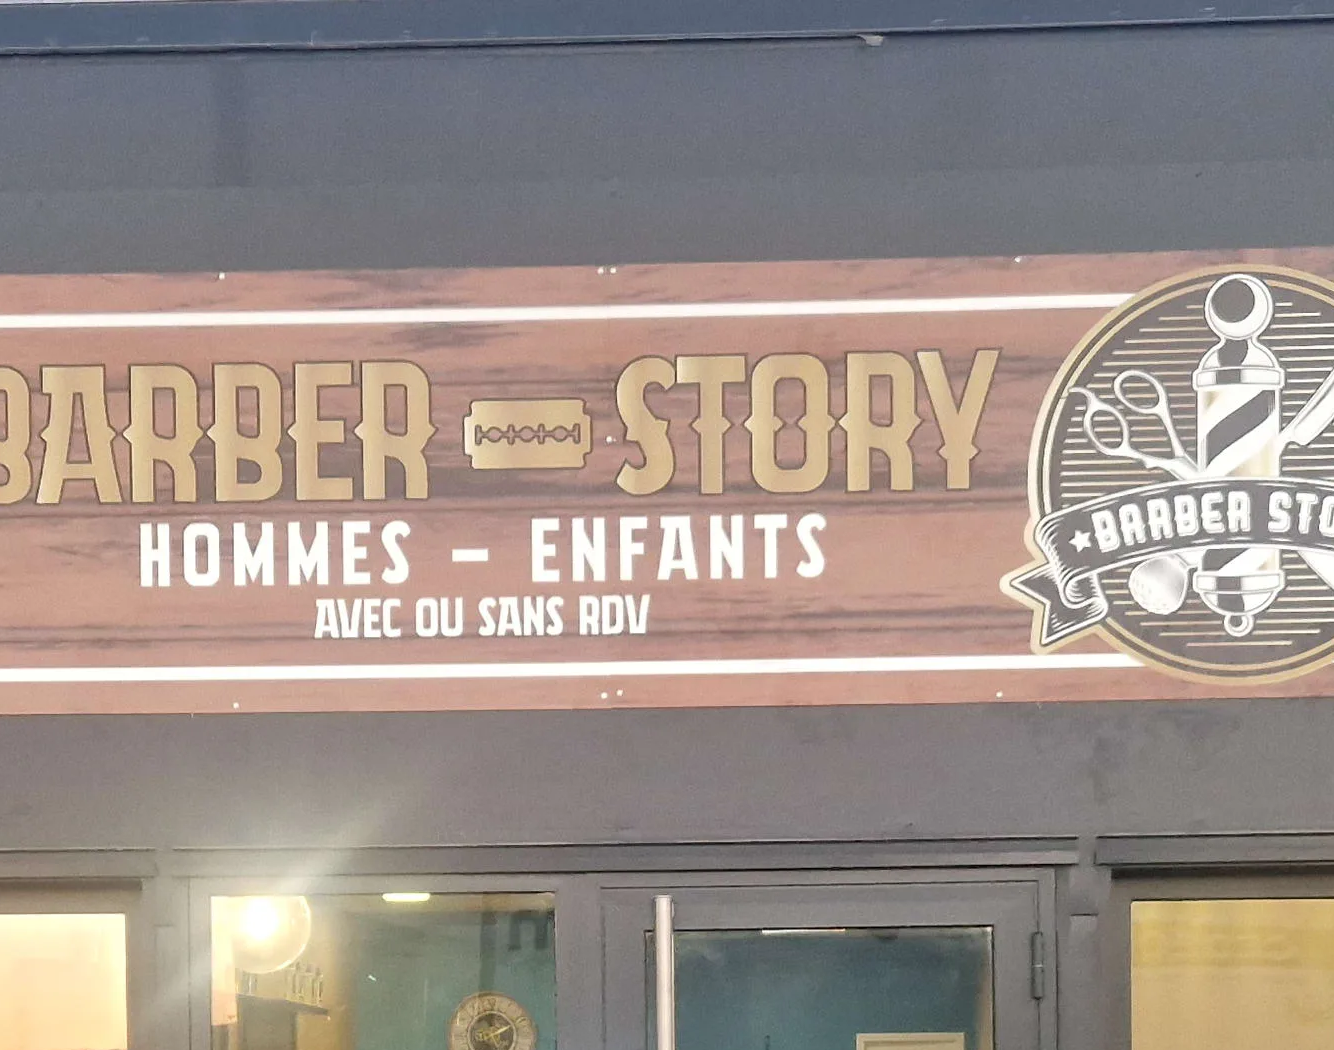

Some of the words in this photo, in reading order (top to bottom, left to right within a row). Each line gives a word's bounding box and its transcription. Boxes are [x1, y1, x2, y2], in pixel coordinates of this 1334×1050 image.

[615, 347, 1003, 497] STORY
[139, 519, 411, 588] HOMMES
[530, 512, 828, 583] ENFANTS
[1091, 490, 1252, 555] BARBER
[313, 596, 402, 639] AVEC
[415, 596, 465, 637] OU
[478, 595, 564, 637] SANS
[577, 593, 650, 635] RDV
